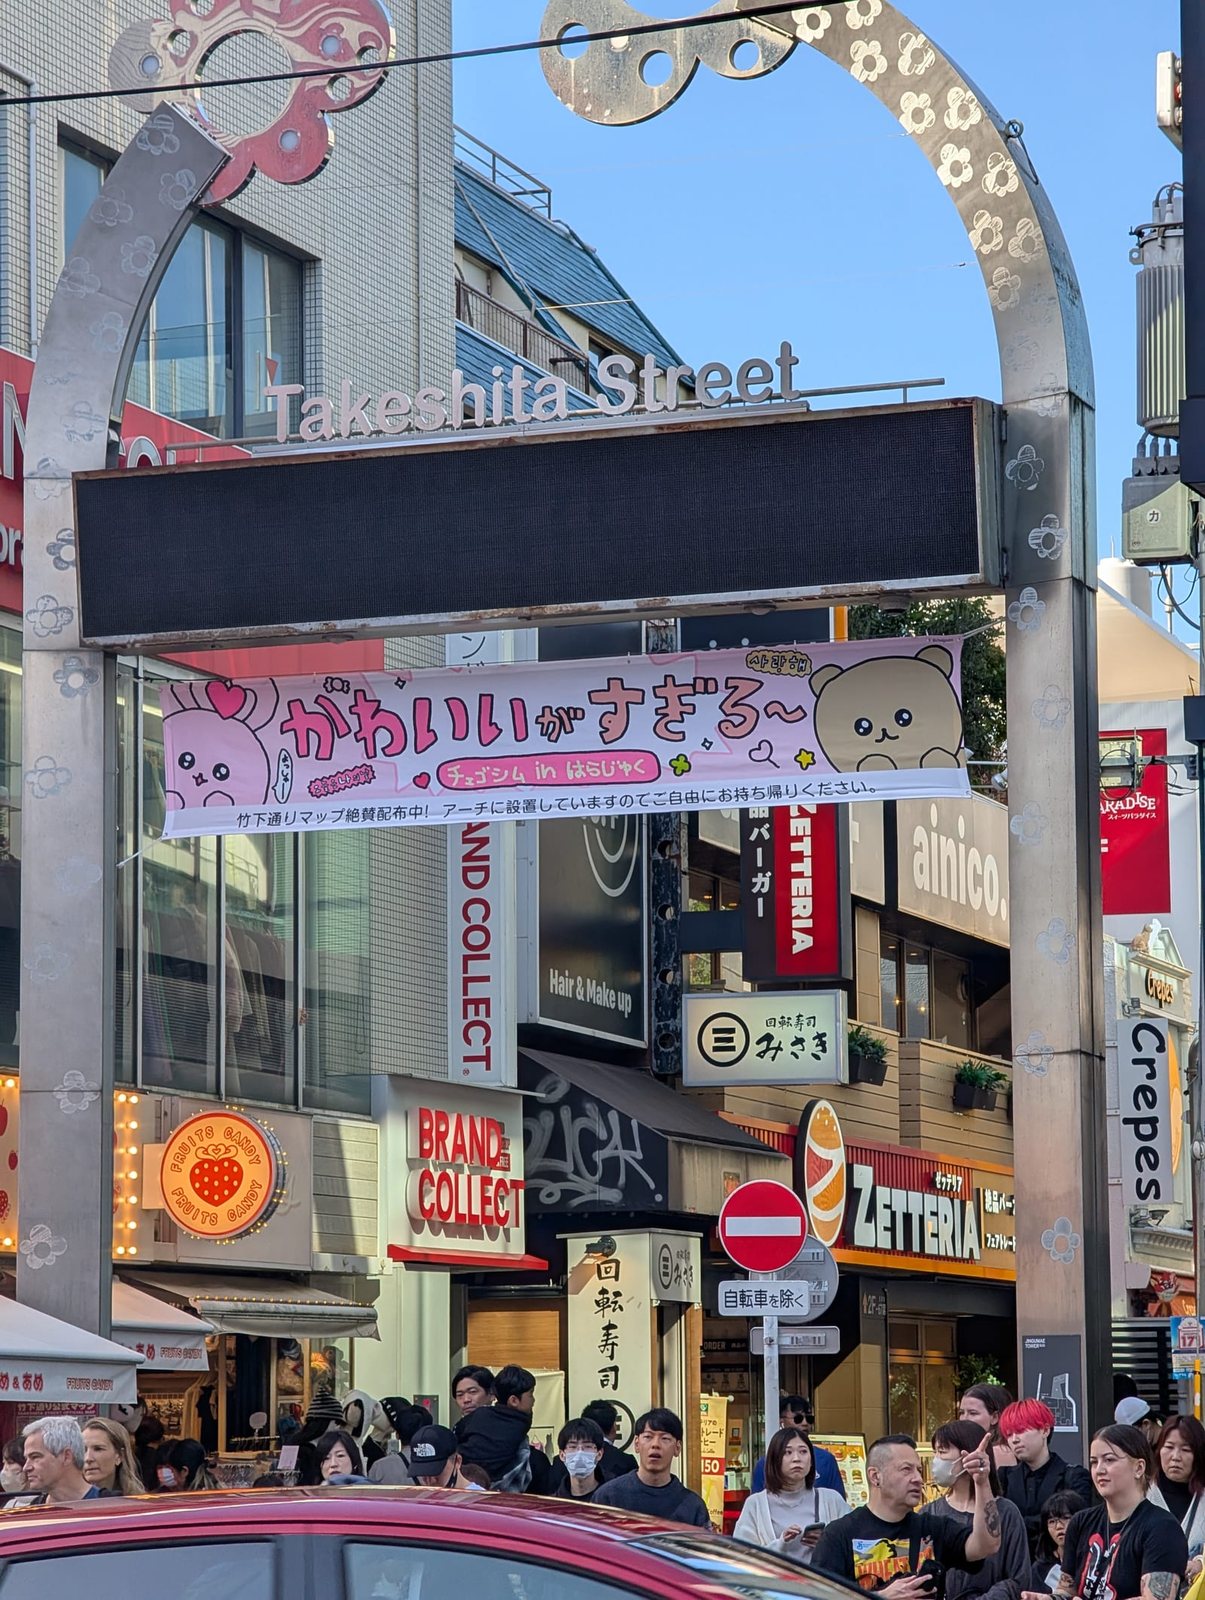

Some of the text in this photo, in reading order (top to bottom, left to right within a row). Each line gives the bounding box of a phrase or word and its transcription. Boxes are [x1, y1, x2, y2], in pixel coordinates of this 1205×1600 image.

[264, 340, 799, 443] Takeshita Street
[749, 654, 808, 673] 사랑해
[447, 758, 648, 786] チェゴシム in はらじゅく
[442, 780, 877, 818] アーチに設置していますのでご自由にお持ち帰りください。
[912, 803, 1007, 921] ainico.
[461, 897, 493, 1072] COLLECT
[549, 967, 632, 1018] Hair & Make up
[1145, 968, 1175, 1008] Crepes
[765, 1013, 817, 1032] 回転寿司
[755, 1031, 828, 1062] みさき
[1122, 1022, 1167, 1201] Crepes
[170, 1125, 262, 1173] FRUITS CANDY
[418, 1107, 503, 1169] BRAND
[171, 1179, 263, 1226] FRUITS CANDY
[418, 1168, 526, 1228] COLLECT
[853, 1163, 981, 1261] ZETTERIA
[724, 1288, 804, 1309] 自転車を除く
[593, 1257, 624, 1392] 回転寿司
[703, 1341, 726, 1350] ORDER
[66, 1377, 91, 1391] FRUITS
[91, 1378, 115, 1391] CANDY
